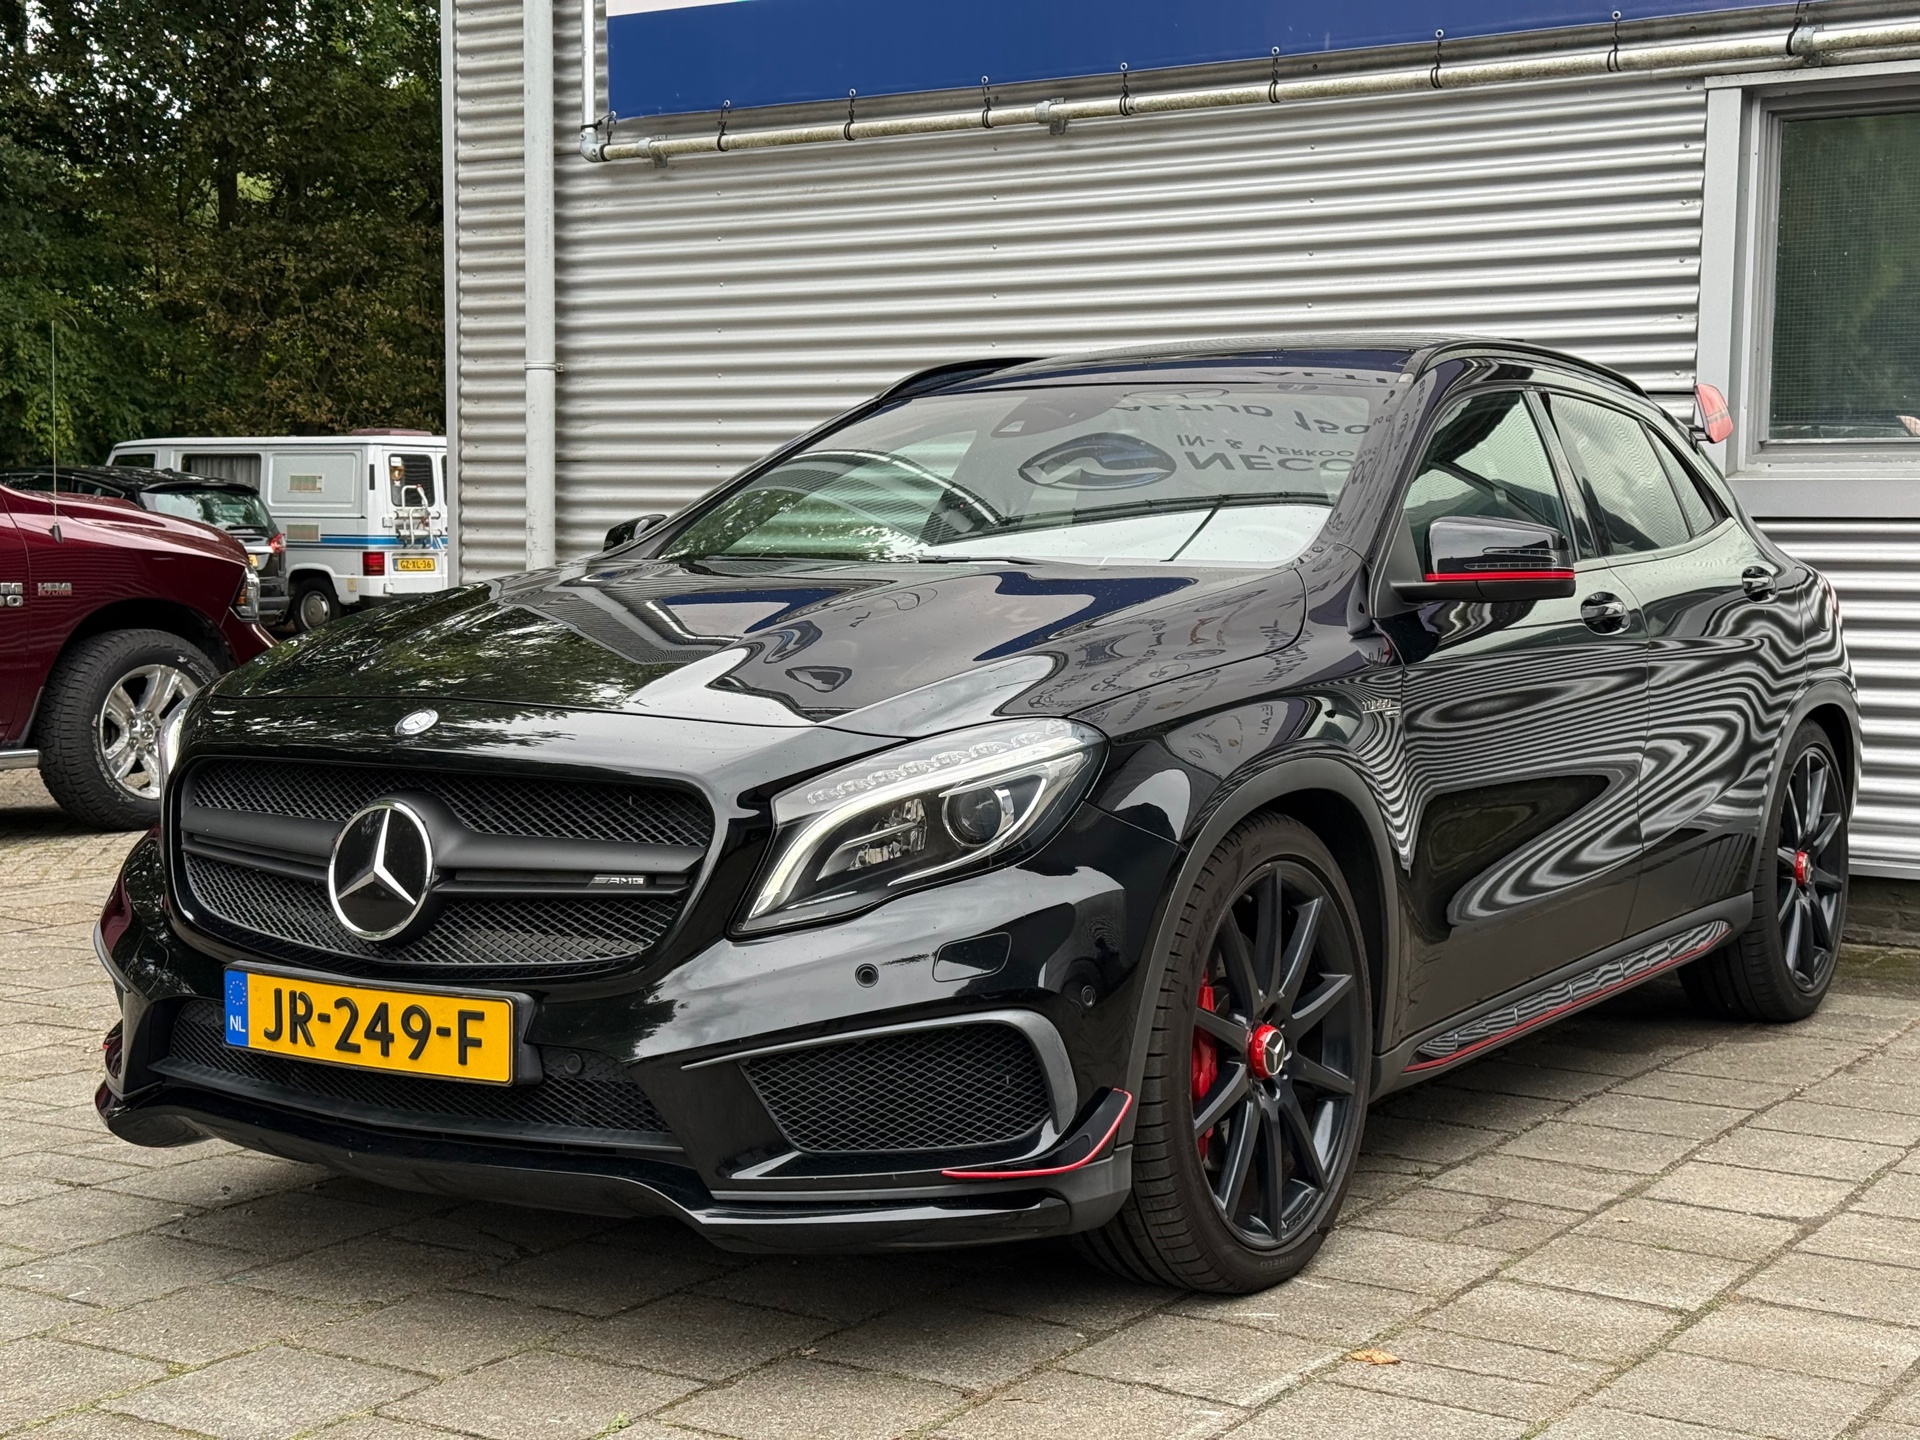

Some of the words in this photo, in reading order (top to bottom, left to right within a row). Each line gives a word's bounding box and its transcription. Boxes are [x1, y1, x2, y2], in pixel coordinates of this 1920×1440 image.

[606, 877, 644, 885] AMG
[229, 1014, 246, 1033] NL
[263, 986, 485, 1066] JR-249-F
